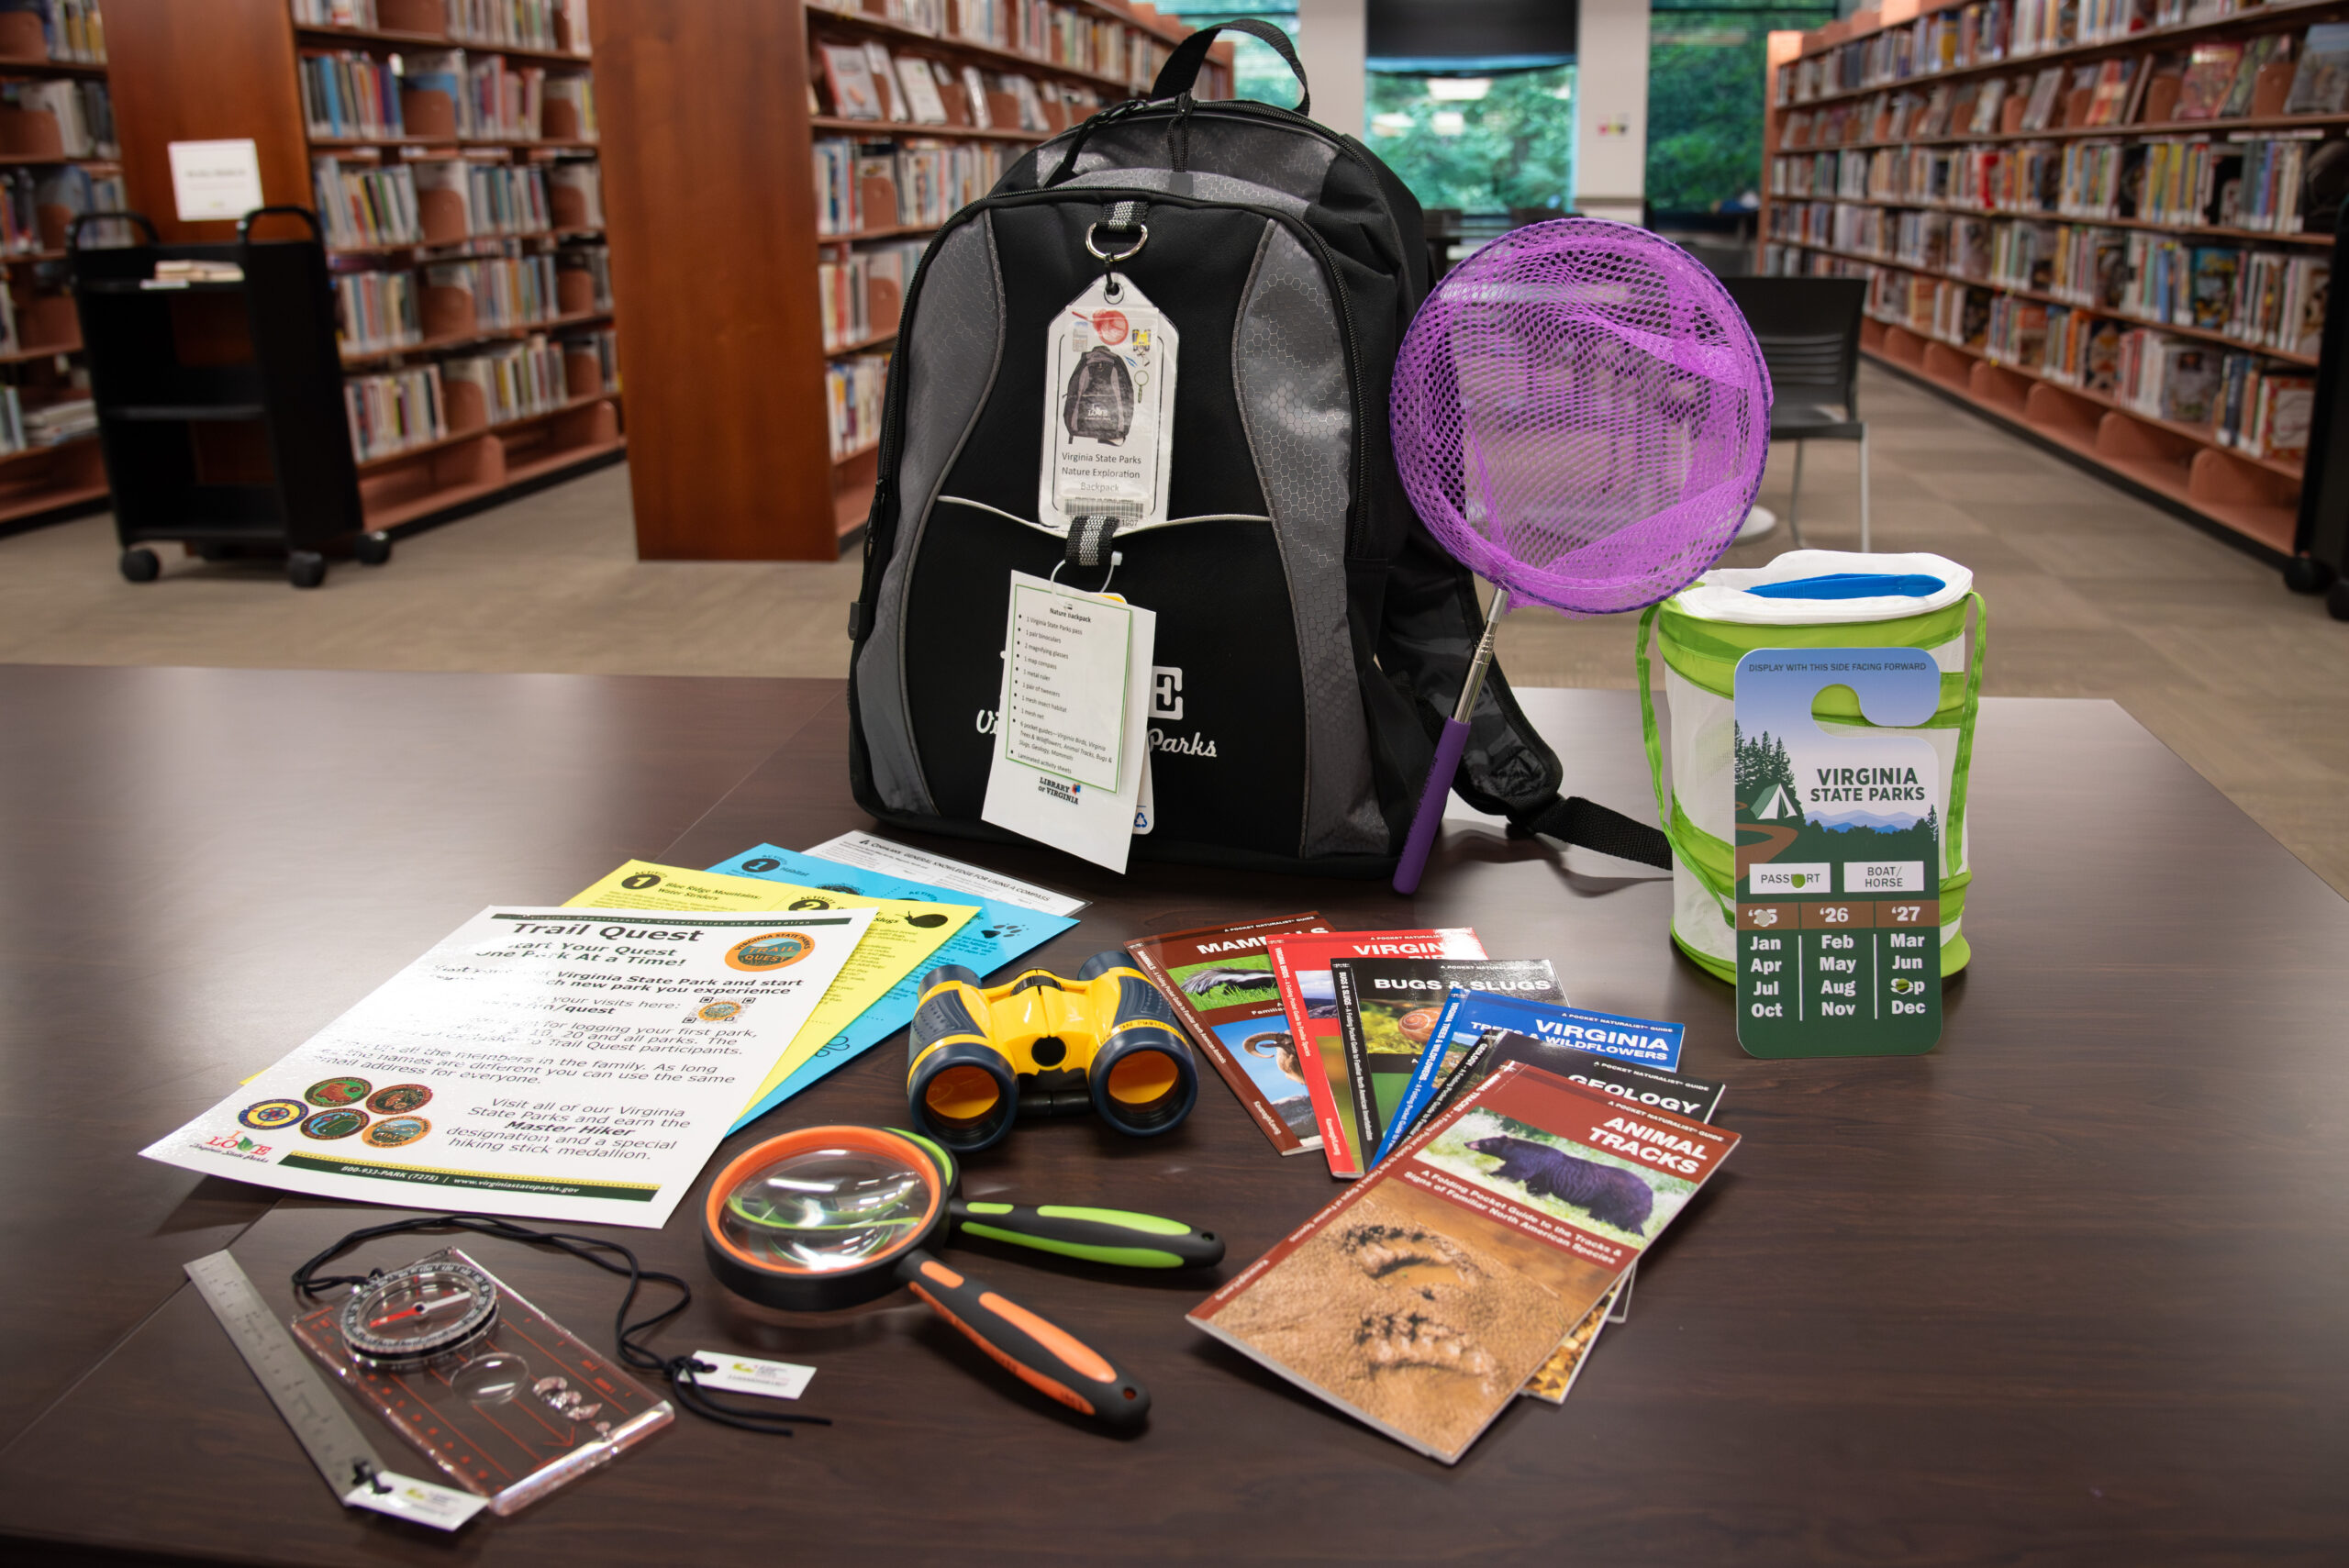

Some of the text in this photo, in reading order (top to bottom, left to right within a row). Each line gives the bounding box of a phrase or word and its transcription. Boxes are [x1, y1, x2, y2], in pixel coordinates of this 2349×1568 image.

[1063, 452, 1141, 464] Virginia State Parks
[1062, 467, 1140, 479] Nature Exploration
[1081, 482, 1119, 493] Backpack
[1050, 608, 1066, 617] Nature
[1030, 617, 1046, 626] Virginia
[1047, 620, 1059, 628] State
[1884, 662, 1926, 671] FORWARD
[1147, 728, 1218, 758] Parks
[1817, 767, 1919, 785] VIRGINIA
[1040, 777, 1070, 793] LIBRARY
[1047, 789, 1079, 805] VIRGINIA
[1810, 787, 1925, 802] STATE PARKS
[1761, 873, 1820, 884] PASSRT
[1867, 866, 1902, 877] BOAT/
[1865, 878, 1903, 887] HORSE
[685, 892, 718, 900] Striders
[512, 924, 704, 941] Trail Quest
[561, 942, 677, 957] Your Quest
[1750, 934, 1925, 951] Jan Feb Mar
[574, 953, 603, 962] At
[627, 956, 686, 967] Time!
[1751, 955, 1922, 974] Apr May Jun
[558, 971, 622, 982] Virginia
[627, 975, 674, 985] State
[1340, 972, 1348, 984] BUGS
[1374, 979, 1442, 990] BUGS
[1470, 980, 1551, 990] SLUGS
[570, 981, 791, 995] new park you experience
[1753, 982, 1779, 995] Jul
[1820, 980, 1856, 996] Aug
[553, 996, 590, 1005] your
[594, 997, 633, 1006] visits
[638, 1000, 681, 1009] here:
[1342, 990, 1352, 1006] SLUGS
[1752, 1000, 1925, 1018] Oct Nov Dec
[1569, 1014, 1598, 1022] POCKET
[637, 1027, 758, 1038] your first park,
[1438, 1023, 1451, 1039] TREES
[1535, 1019, 1669, 1051] VIRGINIA
[587, 1041, 742, 1055] Quest participants.
[1466, 1043, 1487, 1066] GEOLOGY
[1545, 1035, 1667, 1061] WILDFLOWERS
[1419, 1044, 1442, 1081] WILDFLOWERS
[1601, 1063, 1632, 1073] POCKET
[492, 1098, 529, 1109] Visit
[533, 1101, 554, 1110] all
[560, 1104, 580, 1112] of
[620, 1106, 685, 1118] Virginia
[468, 1107, 690, 1129] State Parks and earn the
[1616, 1104, 1646, 1116] POCKET
[1698, 1130, 1724, 1141] GUIDE
[504, 1121, 636, 1136] Master Hiker
[447, 1127, 550, 1144] designation
[555, 1136, 590, 1146] and
[612, 1139, 677, 1152] special
[1603, 1118, 1708, 1160] ANIMAL
[449, 1138, 651, 1160] hiking stick medallion.
[1589, 1127, 1698, 1173] TRACKS
[340, 1164, 406, 1180] 800-933-PARK
[454, 1177, 580, 1194] www.virginiastateparks.gov
[1404, 1171, 1615, 1264] Signs of Familiar North American Species
[1431, 1173, 1468, 1194] Folding
[1470, 1190, 1507, 1208] Pocket
[1508, 1207, 1538, 1223] Guide
[1541, 1219, 1552, 1229] to
[1554, 1226, 1572, 1237] the
[1575, 1234, 1611, 1253] Tracks
[1613, 1249, 1622, 1257] &
